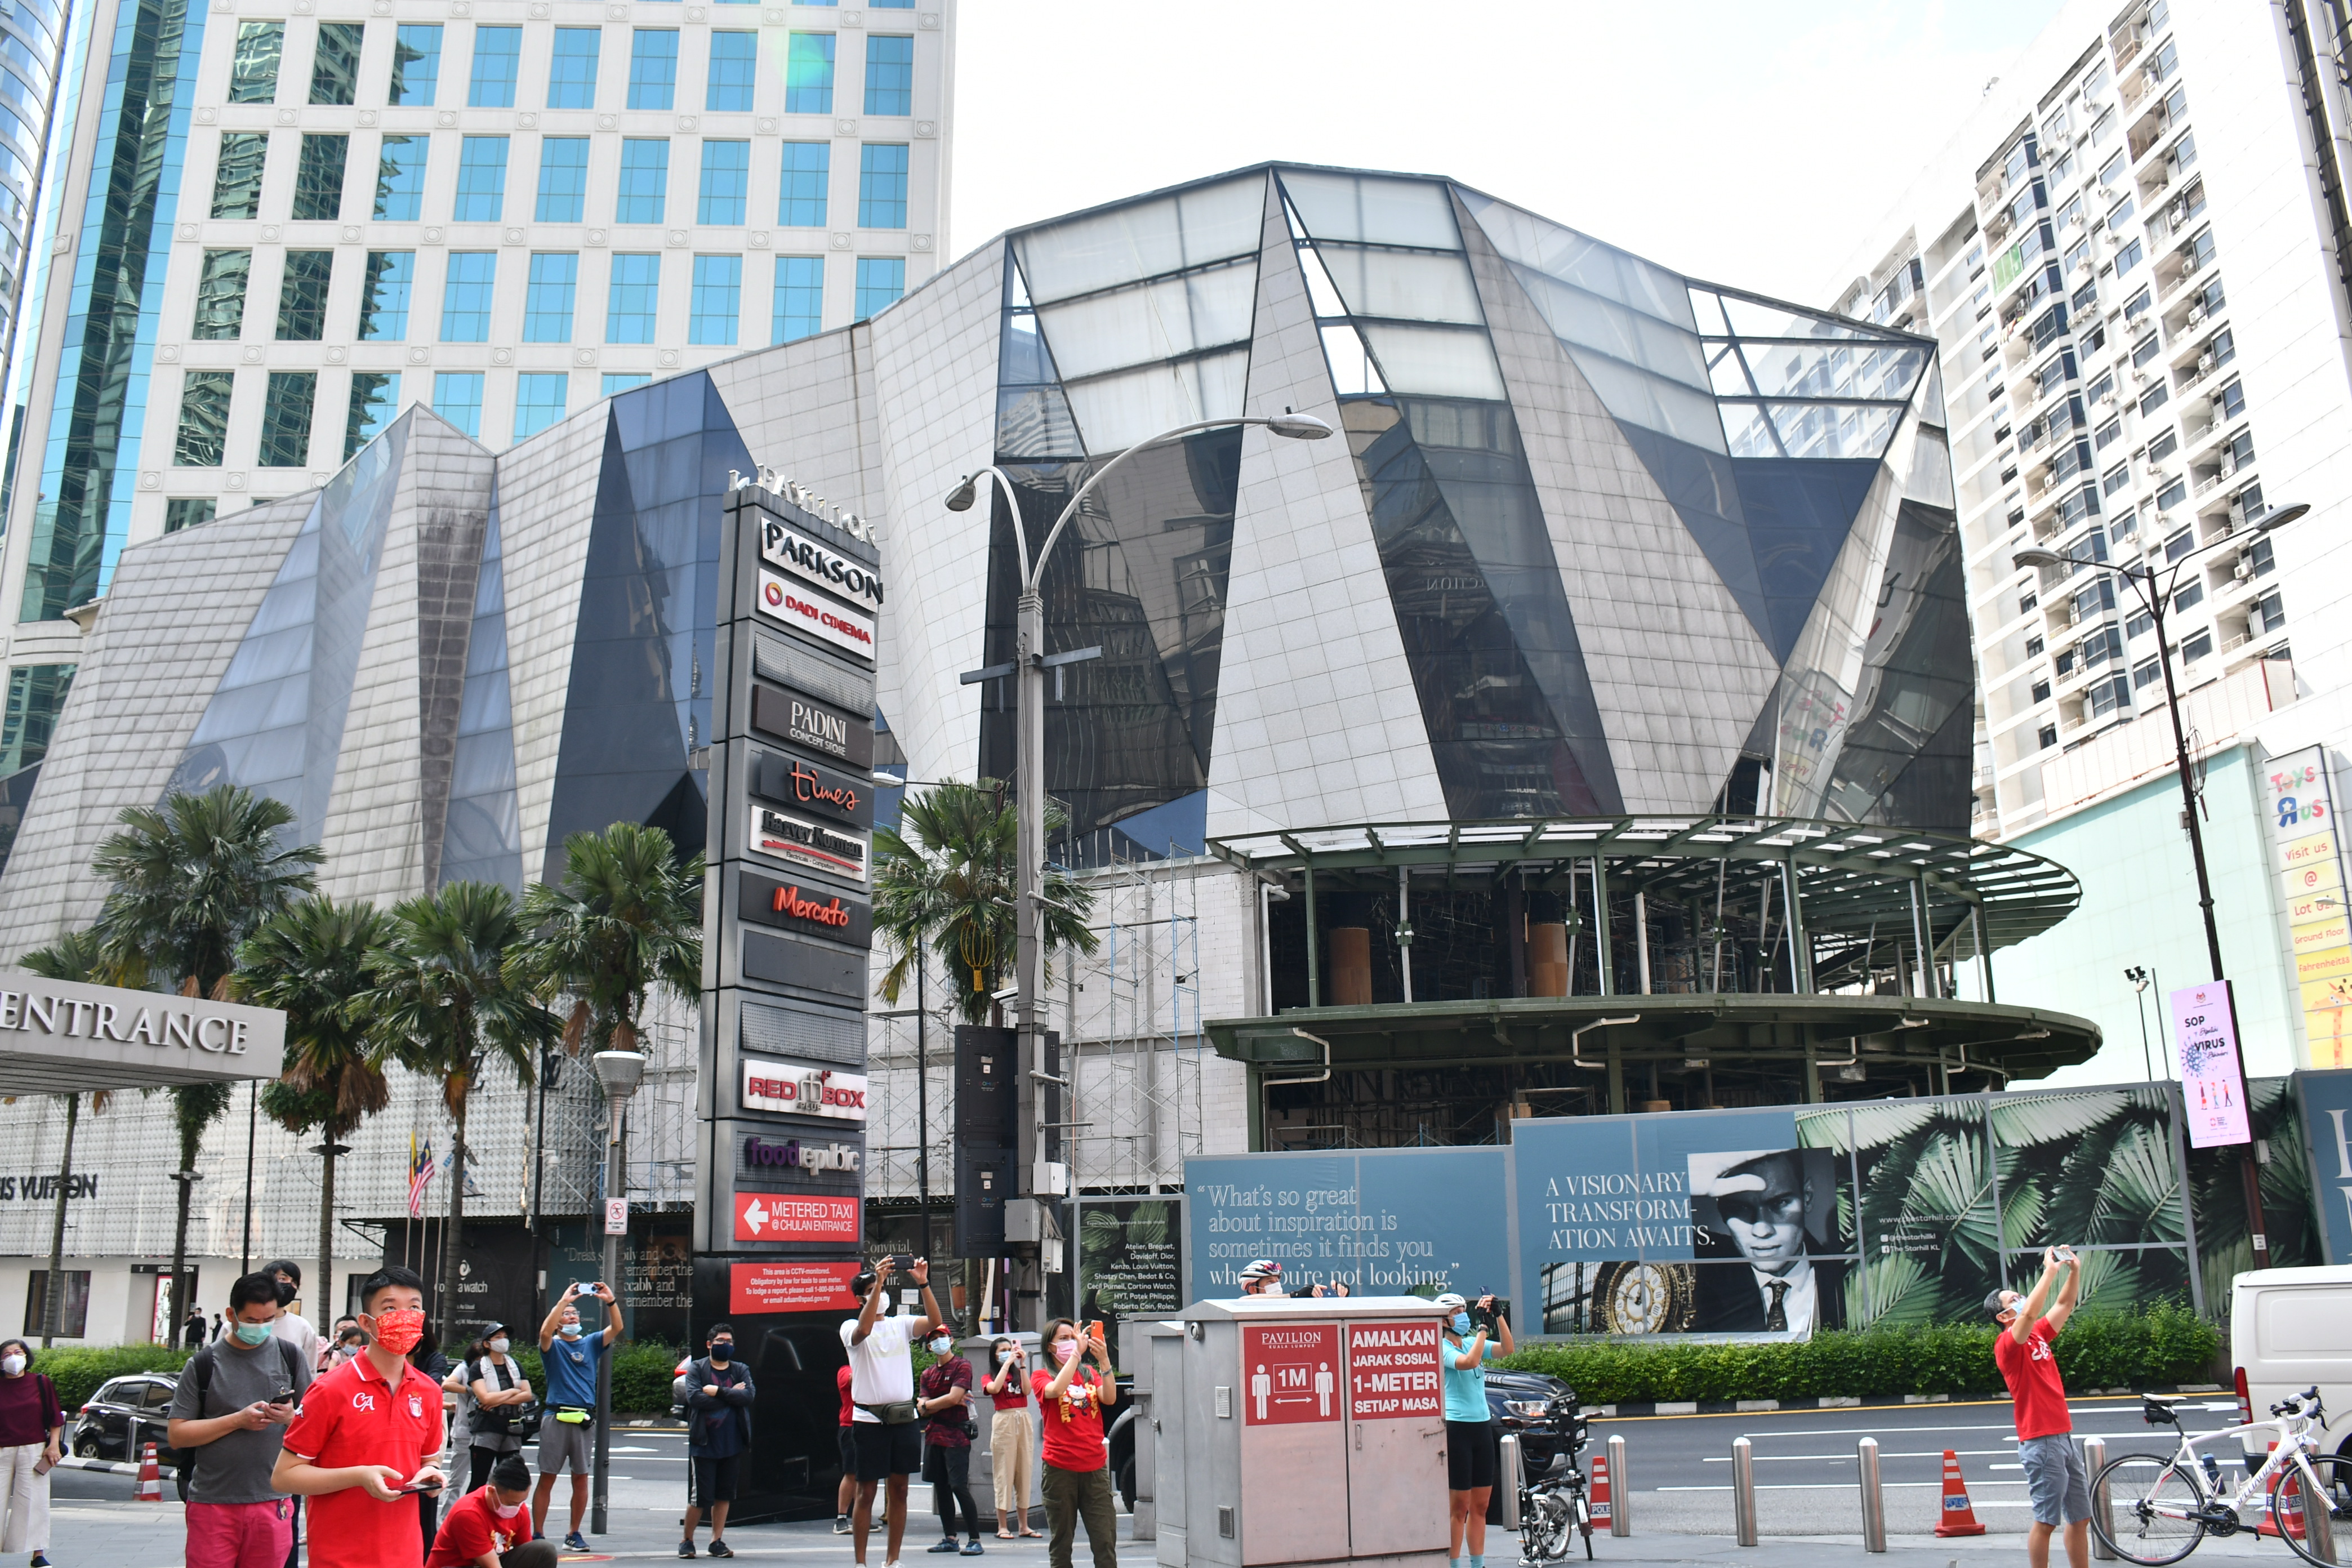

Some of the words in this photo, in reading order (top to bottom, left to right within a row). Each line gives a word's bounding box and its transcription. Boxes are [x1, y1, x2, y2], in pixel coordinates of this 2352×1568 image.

[756, 463, 877, 547] PAVILION
[766, 522, 884, 604] PARKSON
[786, 595, 819, 620] DADI
[821, 612, 872, 645] CINEMA
[790, 701, 847, 745] PADINI
[790, 727, 823, 748] CONCEPT
[825, 739, 846, 756] STORE
[790, 761, 860, 811] times
[762, 810, 812, 843] Harvey
[813, 826, 863, 859] Norman
[786, 851, 809, 863] Electricals
[812, 859, 835, 871] Computers
[2285, 845, 2310, 861] Visit
[2314, 841, 2328, 853] us
[2304, 870, 2318, 887] @
[773, 886, 850, 927] Mercato
[2294, 903, 2311, 916] Lot
[2295, 931, 2323, 945] Ground
[2326, 928, 2345, 938] Floor
[0, 990, 248, 1055] ENTRANCE
[2185, 1015, 2205, 1028] SOP
[2194, 1037, 2225, 1052] VIRUS
[749, 1077, 797, 1101] RED
[822, 1086, 866, 1109] BOX
[1545, 1177, 1560, 1197] A
[1566, 1171, 1686, 1196] VISIONARY
[1277, 1187, 1299, 1206] so
[1305, 1185, 1357, 1212] great
[772, 1201, 828, 1219] METERED
[830, 1203, 853, 1219] TAXI
[1545, 1199, 1697, 1223] TRANSFORM-
[1878, 1213, 1977, 1224] www.thestarhill.com.my
[779, 1219, 813, 1231] CHULAN
[813, 1220, 853, 1232] ENTRANCE
[1209, 1210, 1261, 1232] about
[1268, 1210, 1374, 1238] inspiration
[1381, 1209, 1398, 1231] is
[1548, 1228, 1616, 1250] ATION
[1624, 1224, 1716, 1248] AWAITS.
[640, 1245, 658, 1261] and
[1209, 1236, 1312, 1258] sometimes
[1318, 1236, 1333, 1258] it
[1338, 1233, 1389, 1258] finds
[1396, 1240, 1433, 1264] you
[676, 1261, 694, 1276] the
[1330, 1267, 1362, 1286] not
[464, 1280, 488, 1293] watch
[656, 1277, 676, 1292] and
[676, 1292, 693, 1308] the
[1262, 1331, 1321, 1345] PAVILION
[1352, 1329, 1436, 1349] AMALKAN
[1353, 1354, 1392, 1367] JARAK
[1394, 1352, 1436, 1366] SOSIAL
[1277, 1368, 1307, 1387] 1M
[1353, 1371, 1438, 1393] 1-METER
[1355, 1398, 1400, 1414] SETIAP
[1402, 1397, 1439, 1411] MASA
[1945, 1498, 1969, 1506] POLIS
